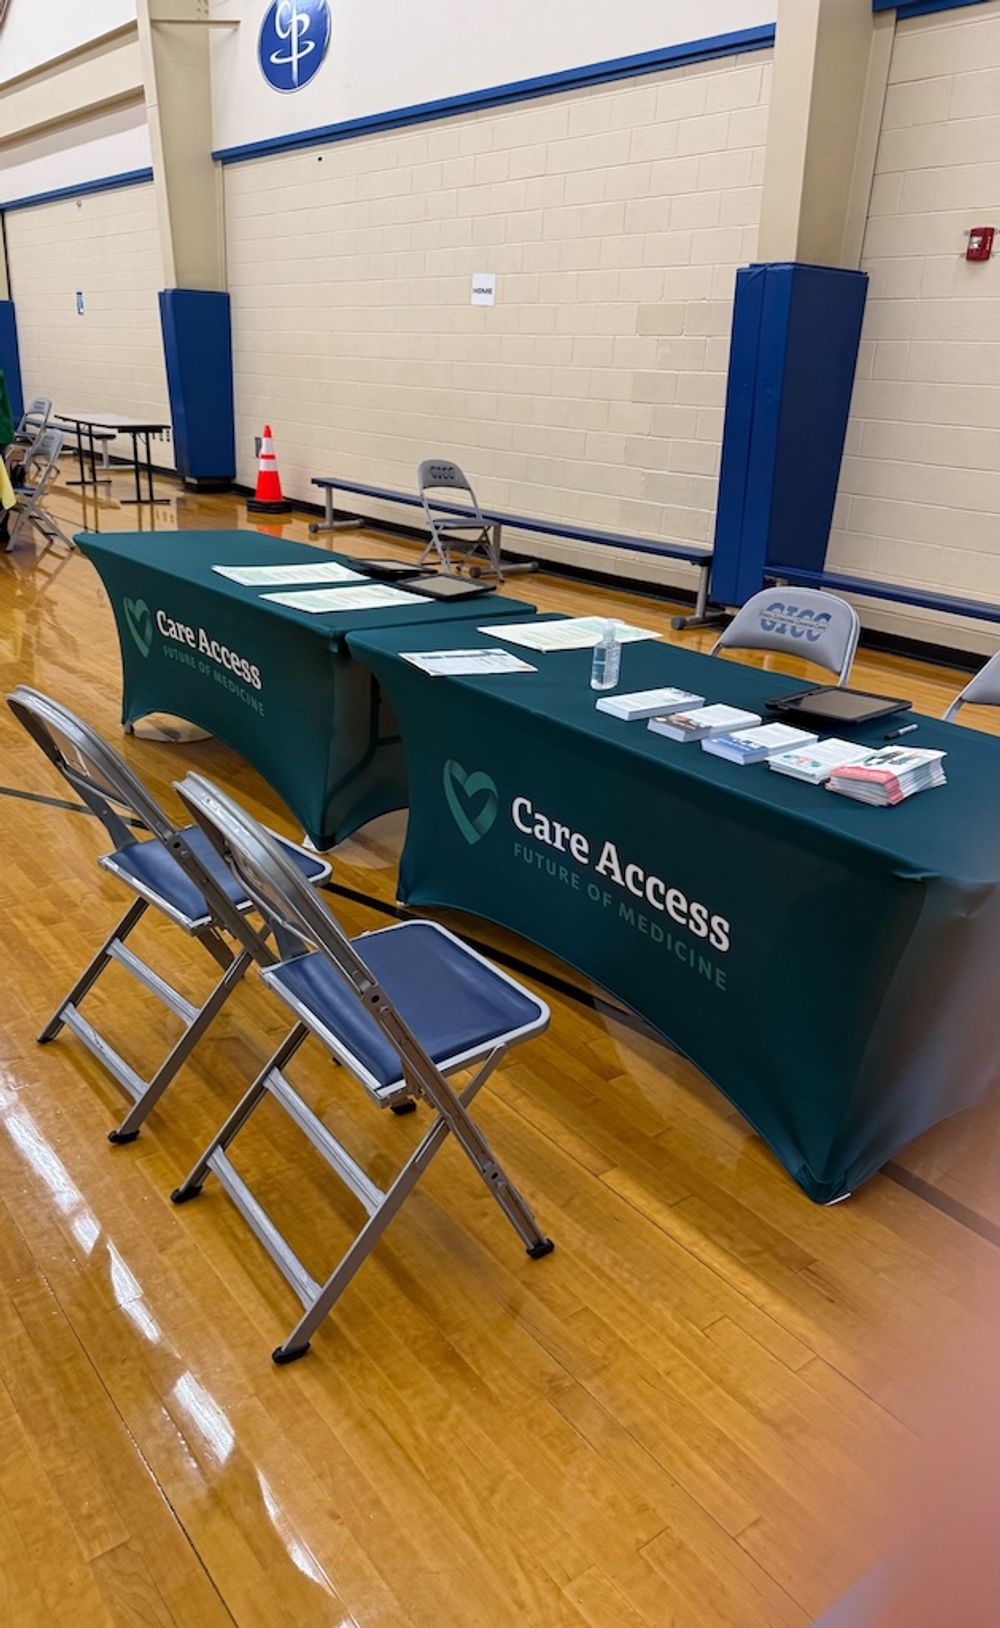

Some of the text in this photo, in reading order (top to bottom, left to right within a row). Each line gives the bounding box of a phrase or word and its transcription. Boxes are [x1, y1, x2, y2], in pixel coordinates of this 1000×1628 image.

[156, 610, 262, 690] Care Access
[163, 645, 265, 717] FUTURE OF MEDICINE
[512, 797, 730, 952] Care Access
[514, 843, 727, 991] FUTURE OF MEDICINE
